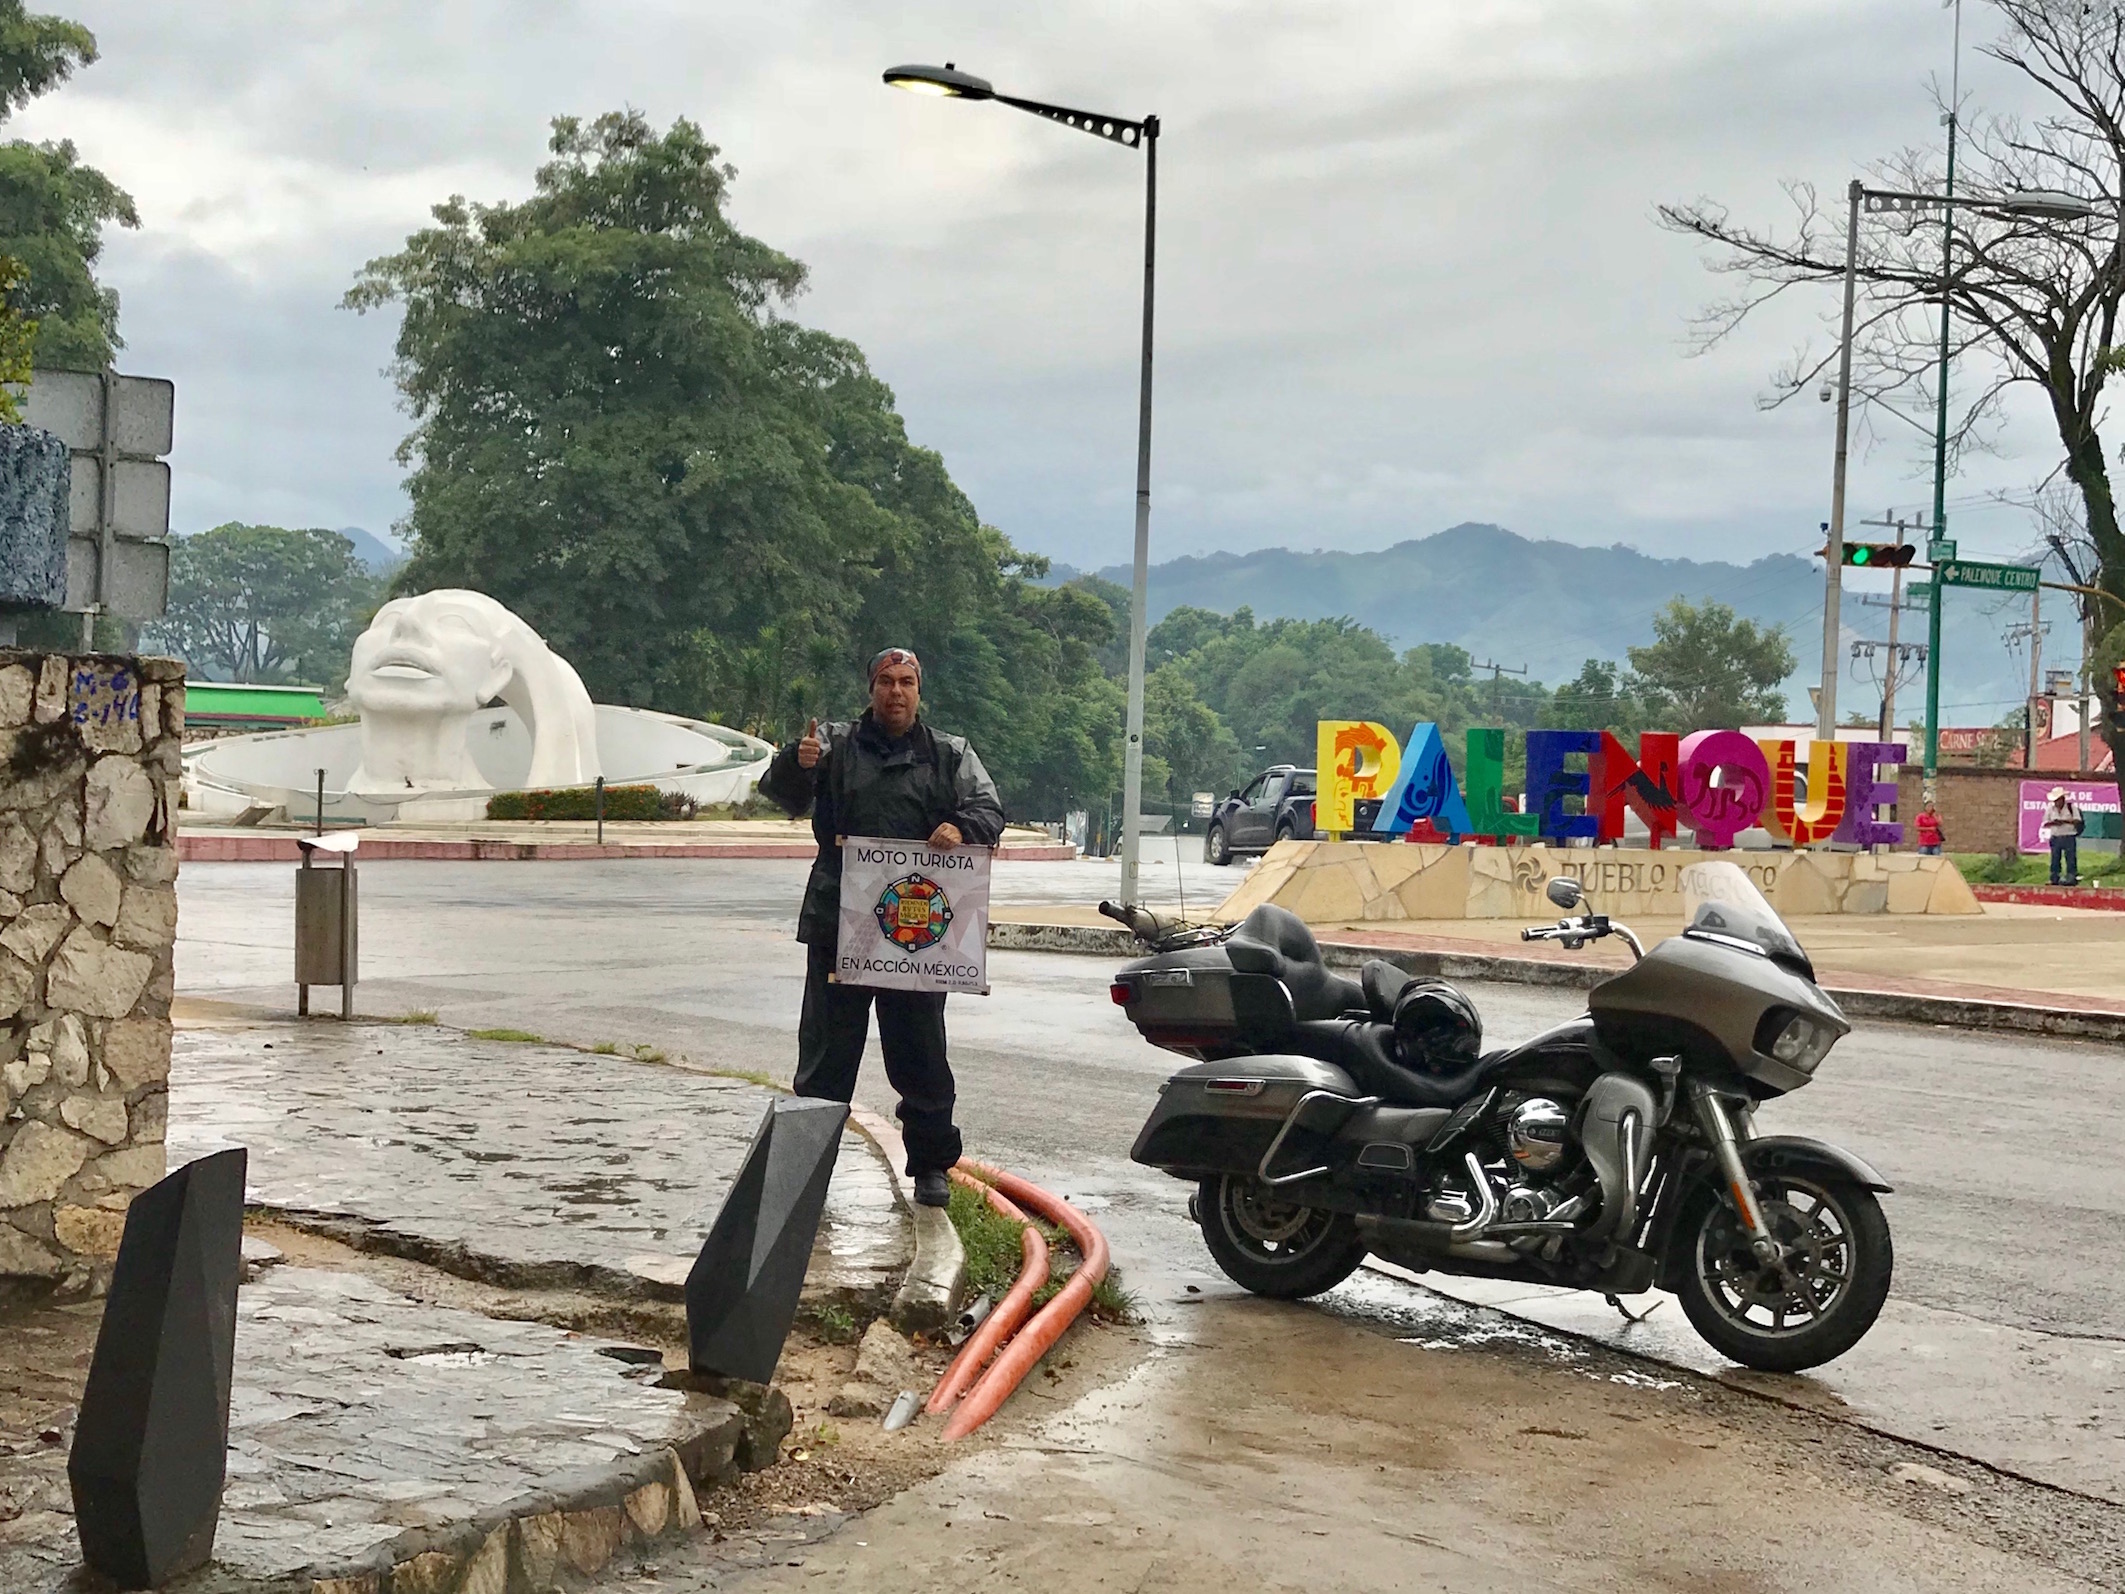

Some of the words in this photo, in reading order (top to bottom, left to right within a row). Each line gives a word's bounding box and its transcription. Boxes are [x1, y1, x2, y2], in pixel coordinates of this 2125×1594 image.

[1960, 566, 2002, 585] PALENQUE
[2004, 570, 2037, 588] CENTRO
[1940, 731, 1973, 749] CARNE
[1316, 720, 1907, 846] PALENQUE
[857, 848, 907, 865] MOTO
[912, 852, 974, 870] TURISTA
[1560, 862, 1665, 893] PUEBLO
[842, 957, 860, 969] EN
[863, 958, 920, 974] ACCIÓN
[924, 961, 979, 978] MÉXICO
